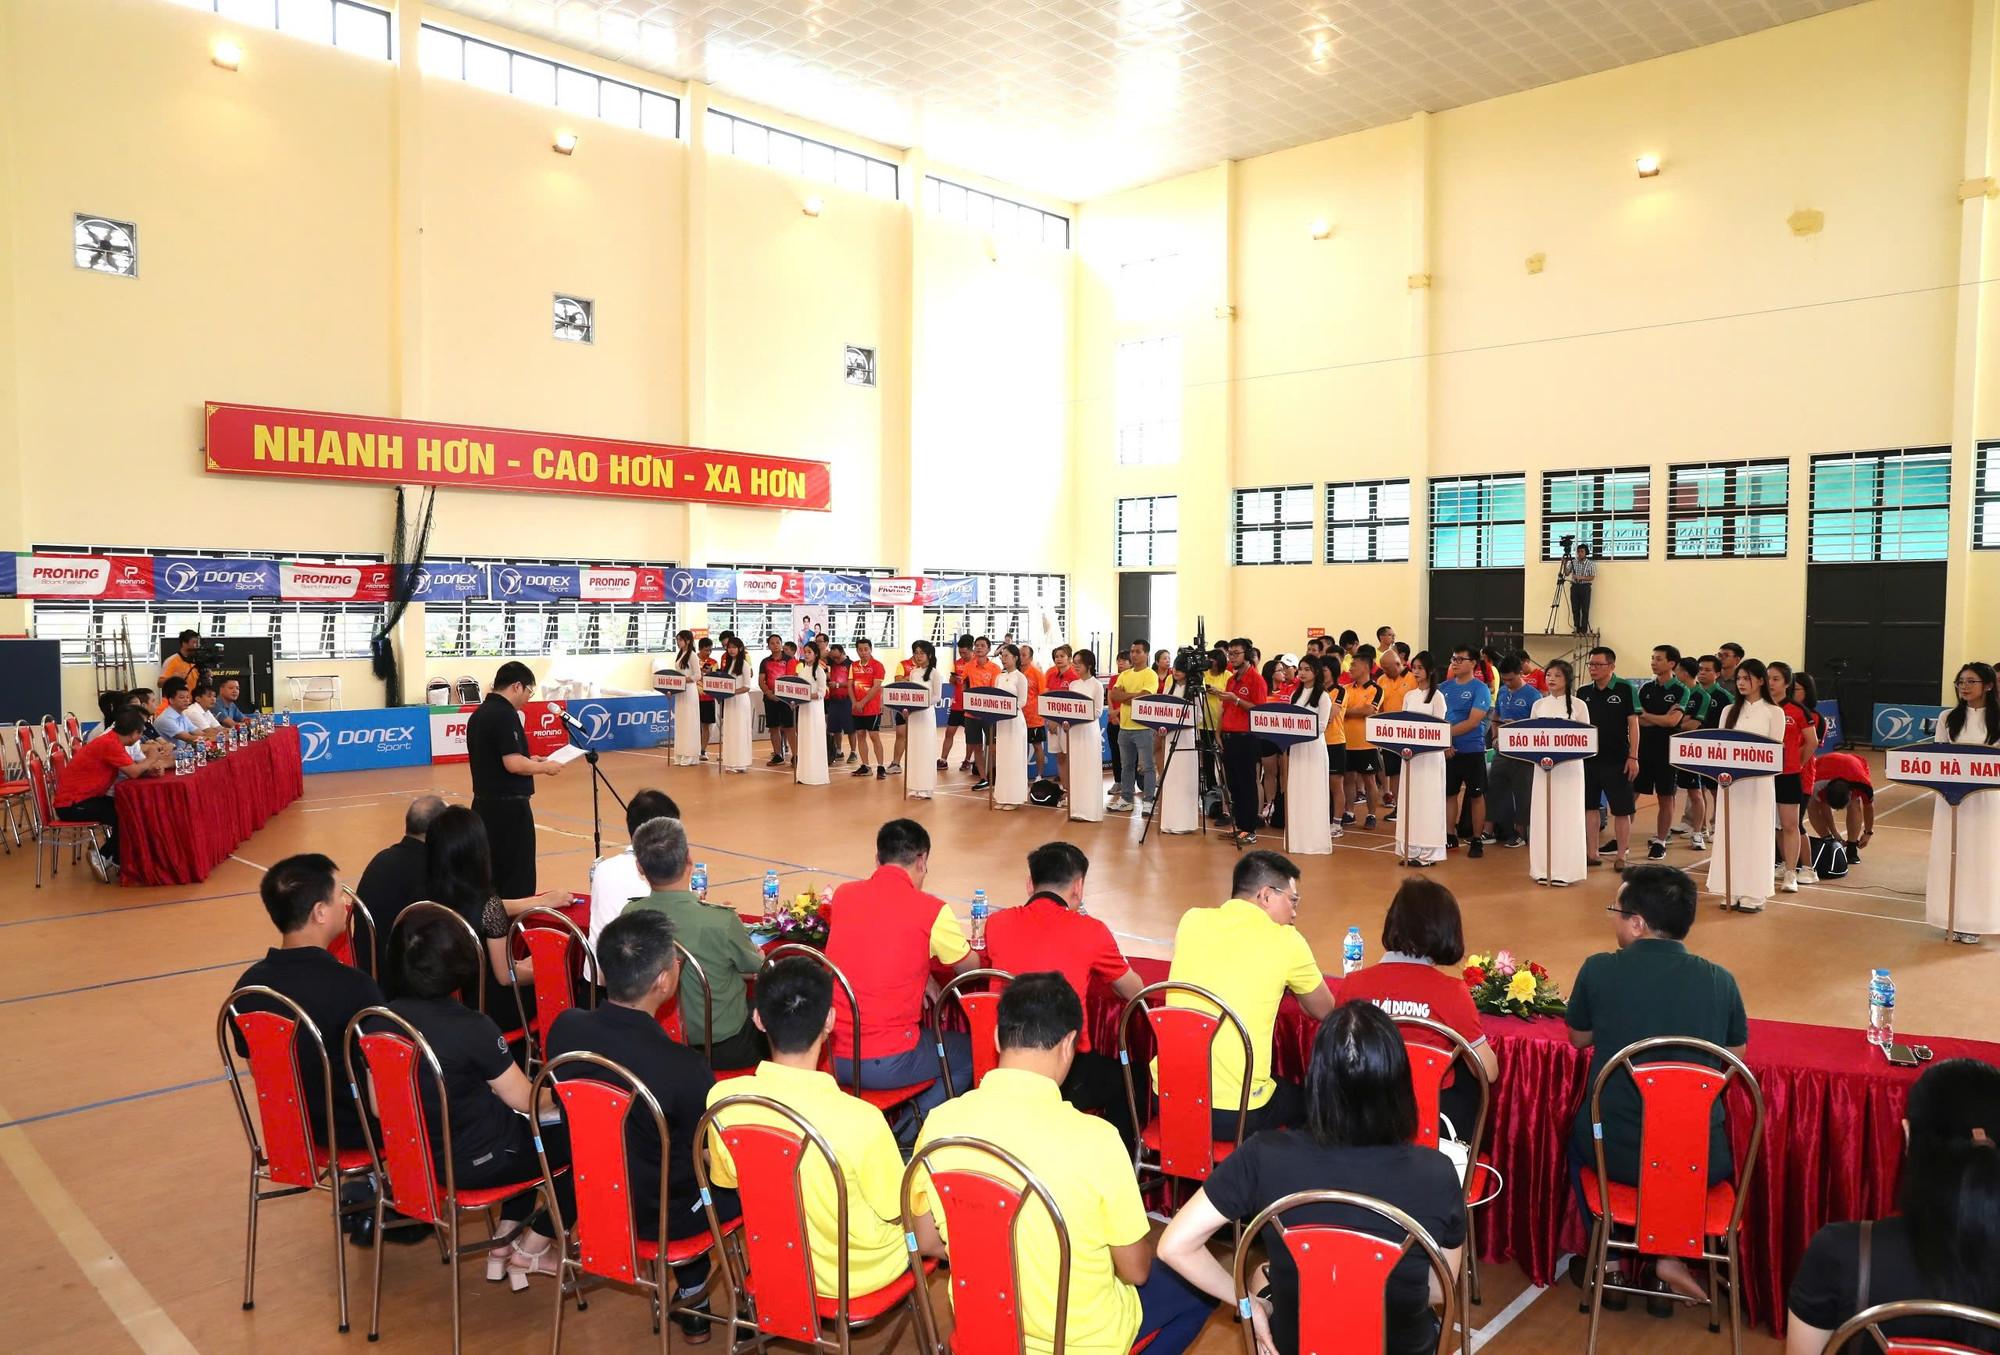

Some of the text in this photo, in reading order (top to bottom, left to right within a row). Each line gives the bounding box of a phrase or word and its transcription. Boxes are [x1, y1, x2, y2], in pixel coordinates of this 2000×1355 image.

[254, 424, 403, 469] NHANH
[418, 438, 494, 476] HƠN
[532, 448, 598, 483] CAO
[610, 454, 674, 488] HƠN
[704, 462, 742, 494] XA
[750, 468, 806, 500] HƠN
[32, 568, 100, 579] PRONING
[203, 572, 266, 583] DONEX
[293, 574, 352, 584] PRONING
[434, 574, 477, 585] DONEX
[525, 576, 571, 586] DONEX
[590, 578, 630, 586] PRONING
[697, 578, 729, 588] DONEX
[743, 581, 777, 589] PRONING
[828, 583, 863, 592] DONEX
[970, 697, 981, 707] BÁO
[1047, 702, 1072, 714] TRỌNG
[1139, 704, 1191, 720] BÁO NHÂN DN
[1255, 715, 1312, 731] BÁO HÀ NỘI MỚI
[337, 726, 415, 745] DONEX
[1376, 724, 1441, 741] BÁO THÁI BÌNH
[1509, 730, 1588, 747] BÁO HẢI DƯƠNG
[377, 742, 411, 753] Sport
[1680, 743, 1773, 763] BÁO HẢI PHÒNG
[1901, 757, 1931, 775] BÁO
[1940, 758, 1961, 775] HÀ
[1392, 1000, 1430, 1018] DƯƠNG
